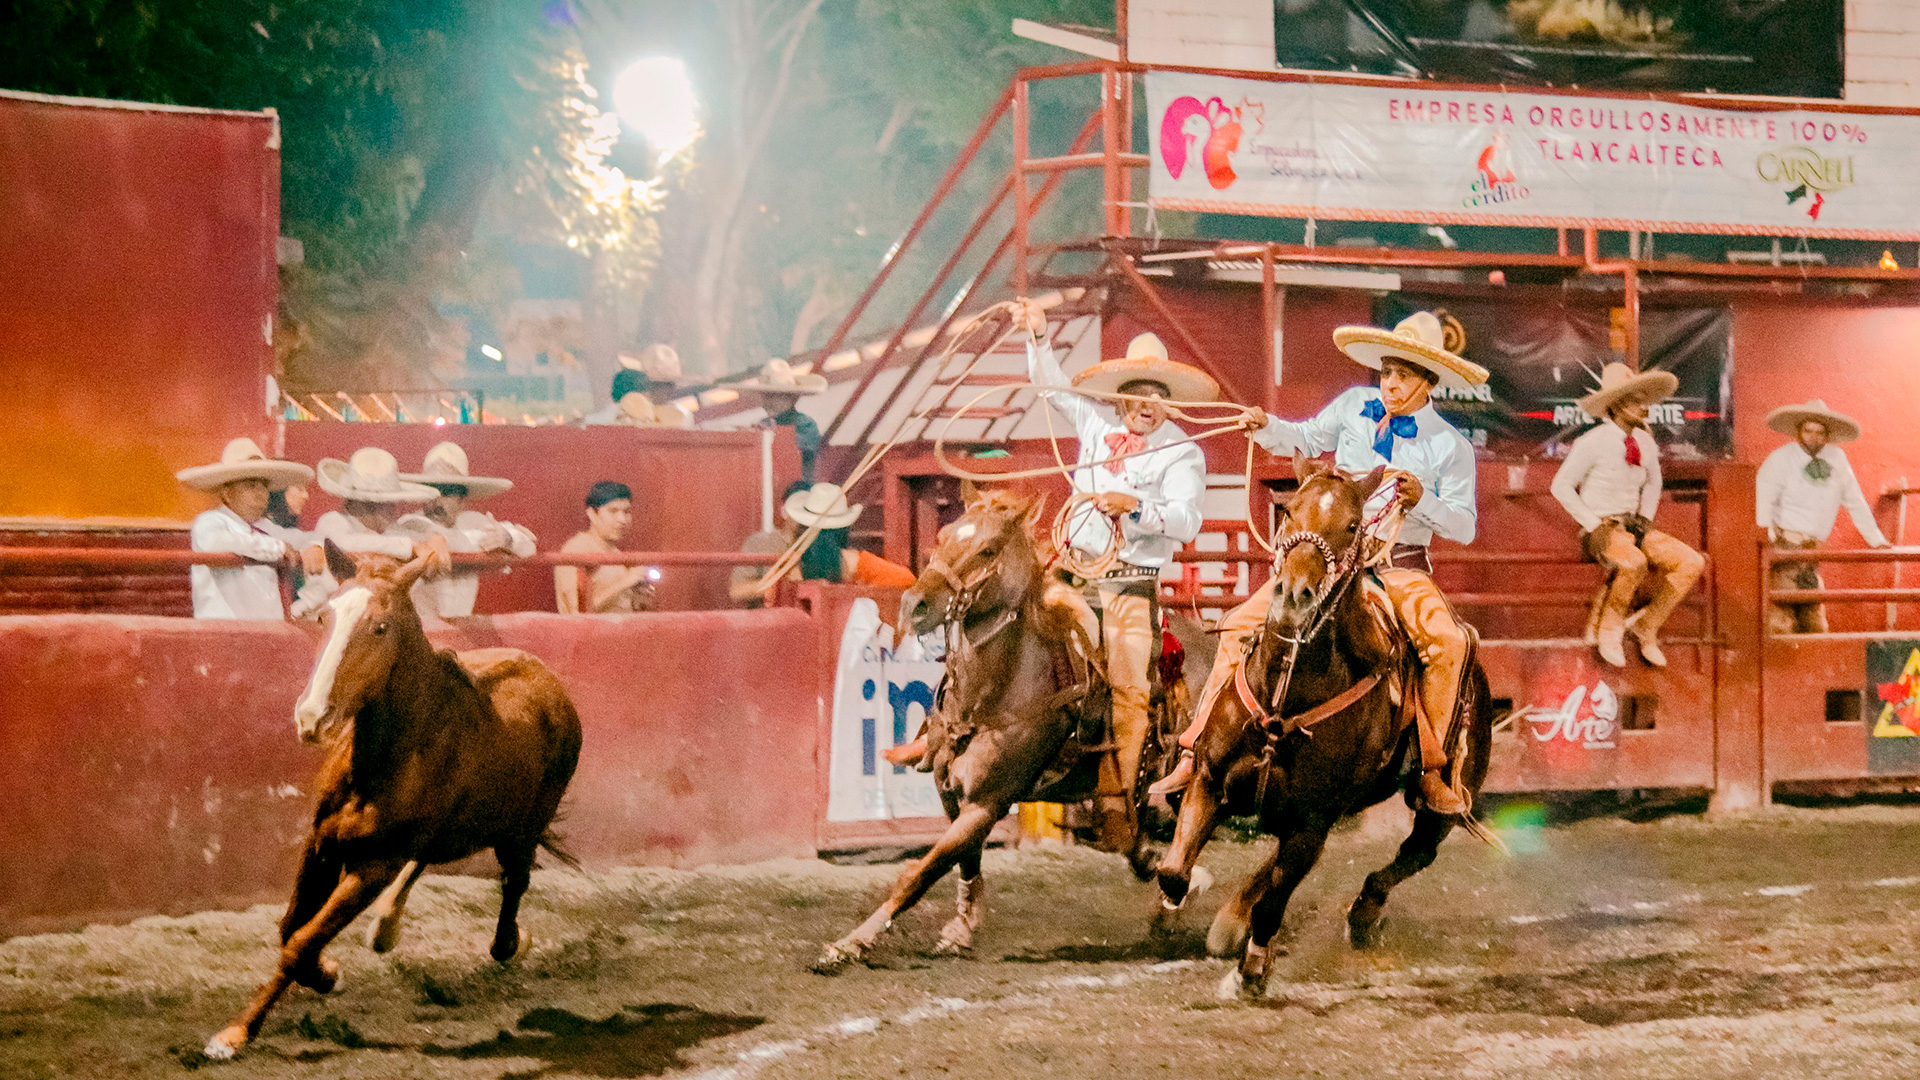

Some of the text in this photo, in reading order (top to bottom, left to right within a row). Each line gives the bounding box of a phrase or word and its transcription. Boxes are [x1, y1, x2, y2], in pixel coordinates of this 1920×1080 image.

[1389, 100, 1868, 143] EMPRESA ORGULLOSAMENTE 100%
[1538, 140, 1724, 168] TLAXCALTECA
